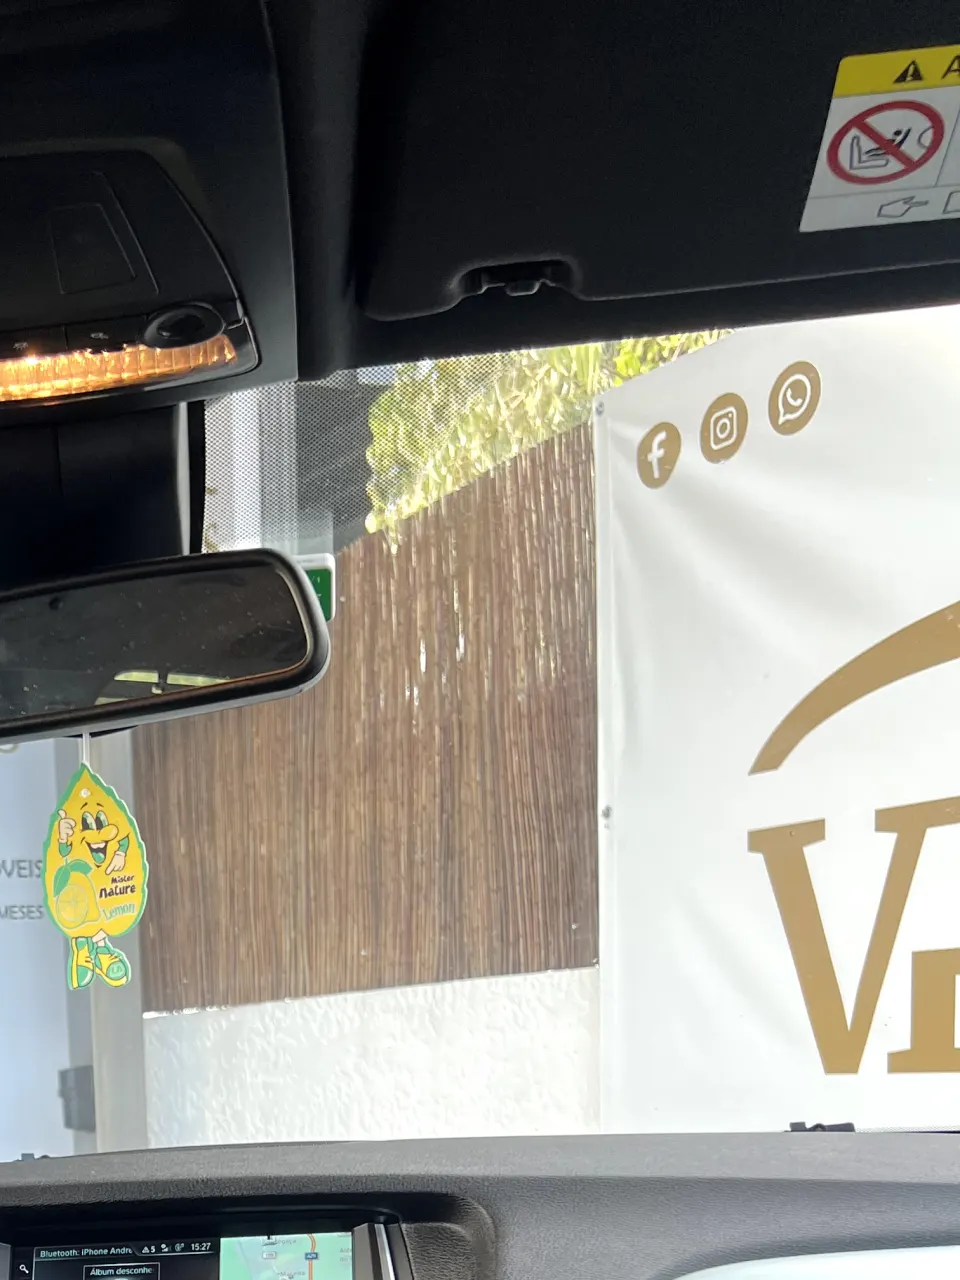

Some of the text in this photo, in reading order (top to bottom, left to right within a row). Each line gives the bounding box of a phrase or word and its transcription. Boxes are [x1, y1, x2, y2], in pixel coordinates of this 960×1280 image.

[111, 875, 135, 885] Mister
[103, 903, 136, 921] Lemon
[150, 1245, 156, 1253] 5
[190, 1242, 211, 1251] 15:27
[40, 1249, 80, 1258] Bluetooth:
[81, 1247, 108, 1257] iPhone
[89, 1267, 114, 1277] Álbum
